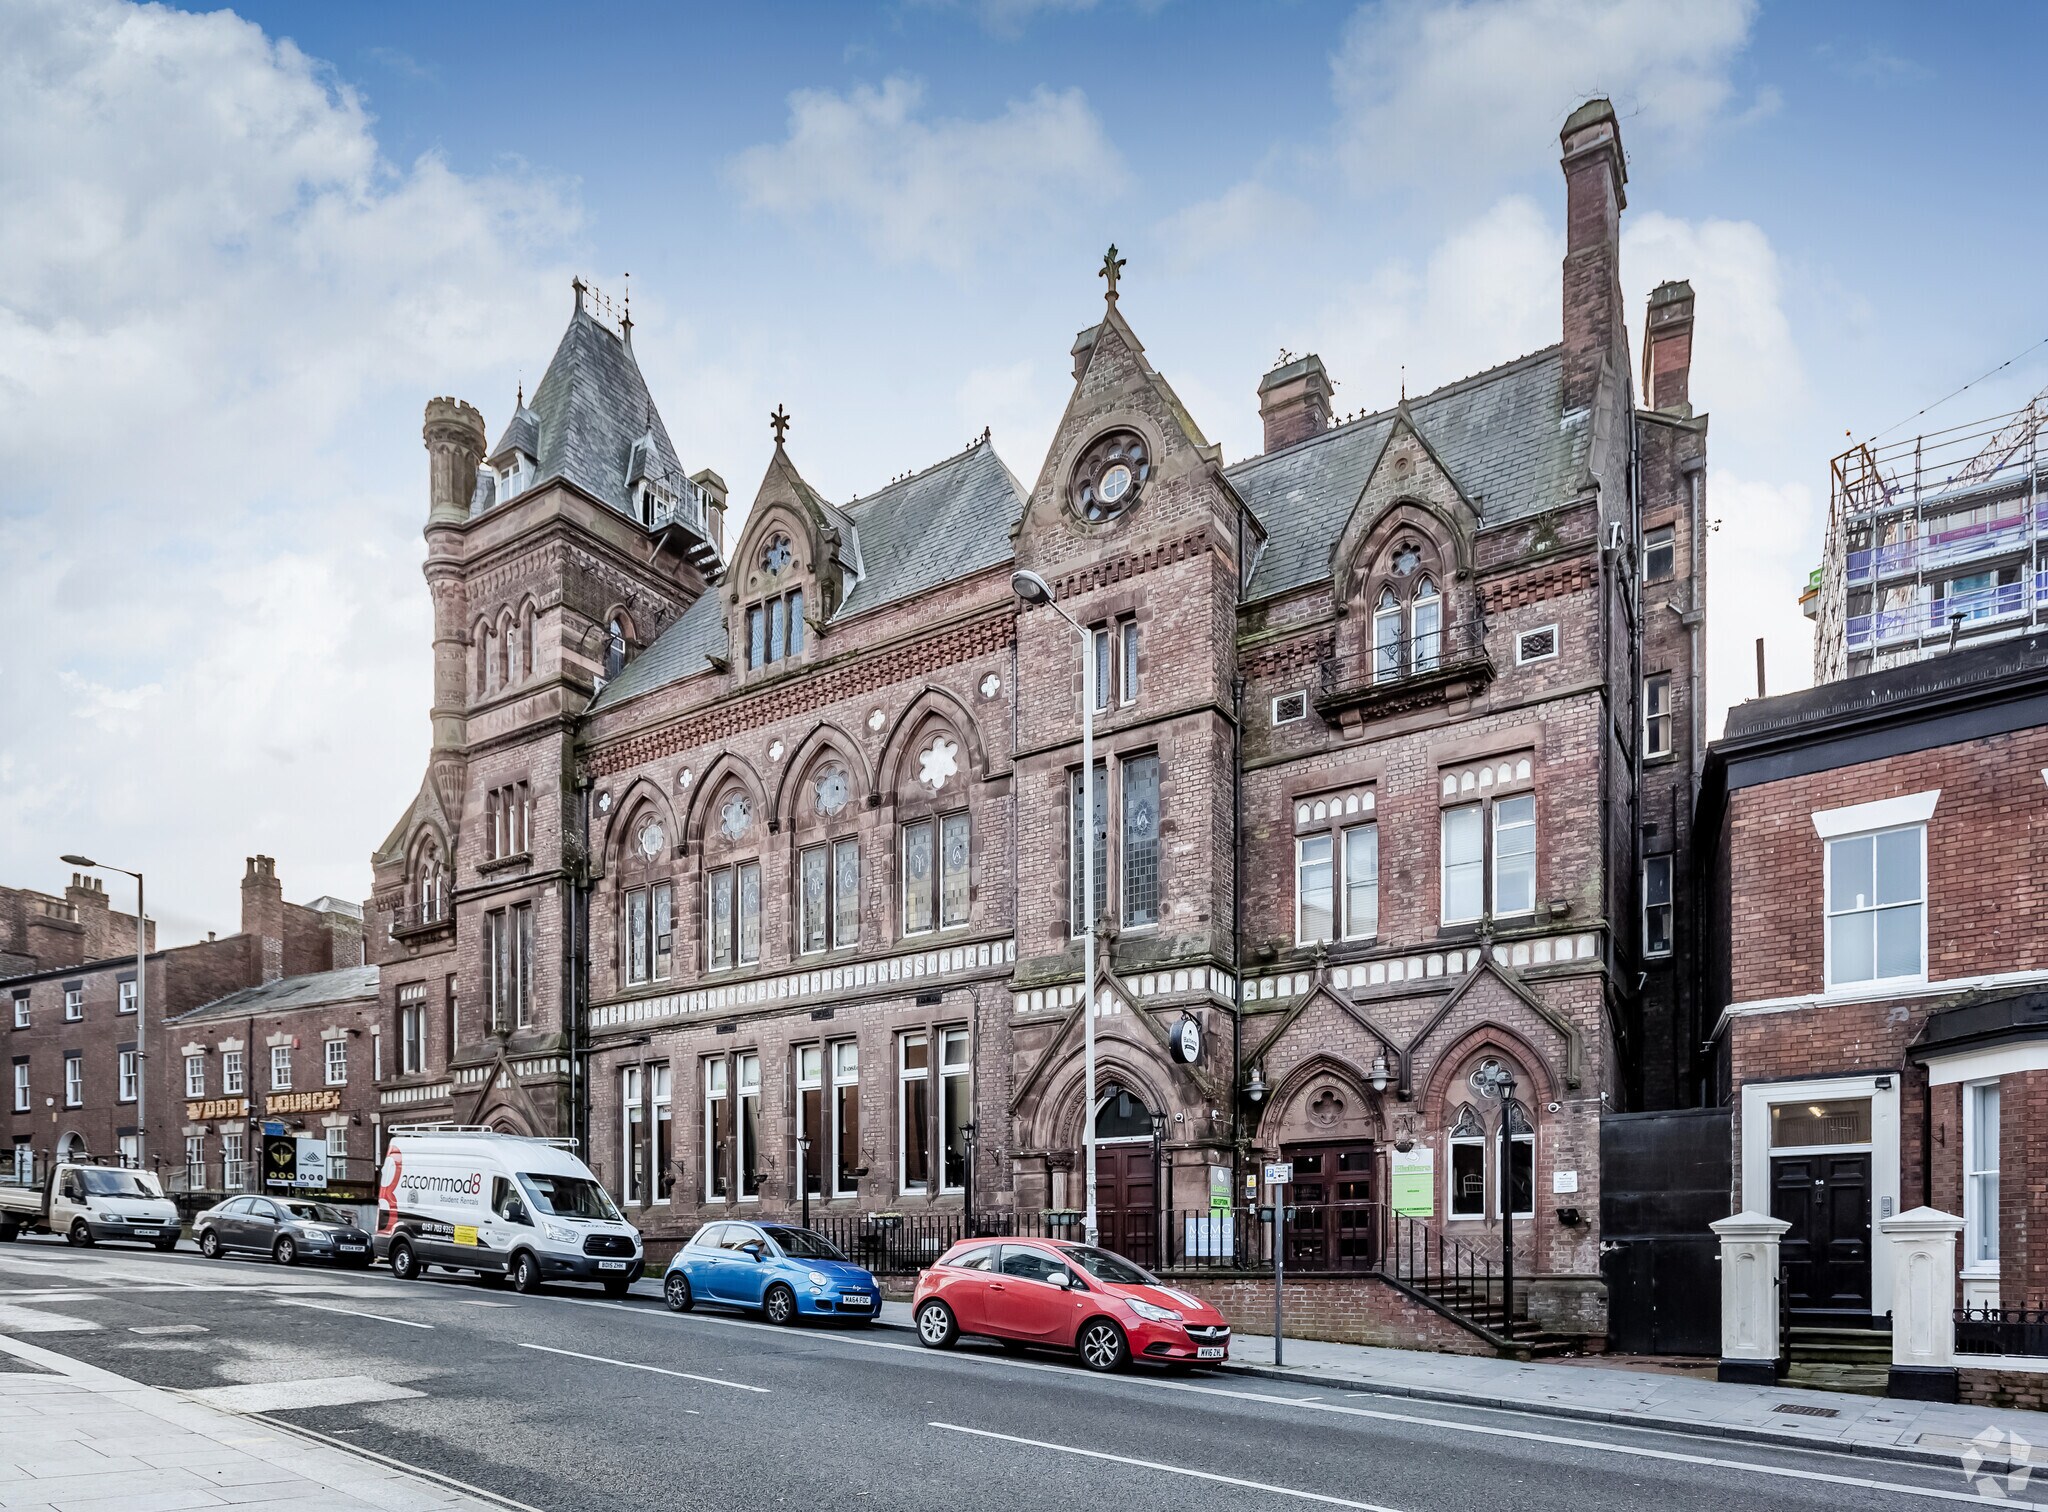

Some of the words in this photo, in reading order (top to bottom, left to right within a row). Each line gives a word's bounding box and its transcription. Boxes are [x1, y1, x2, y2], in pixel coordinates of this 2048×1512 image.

[790, 965, 888, 994] CHRISTIAN
[266, 1091, 335, 1114] LOUNGE
[401, 1173, 481, 1194] accommod8
[421, 1223, 433, 1232] 0151
